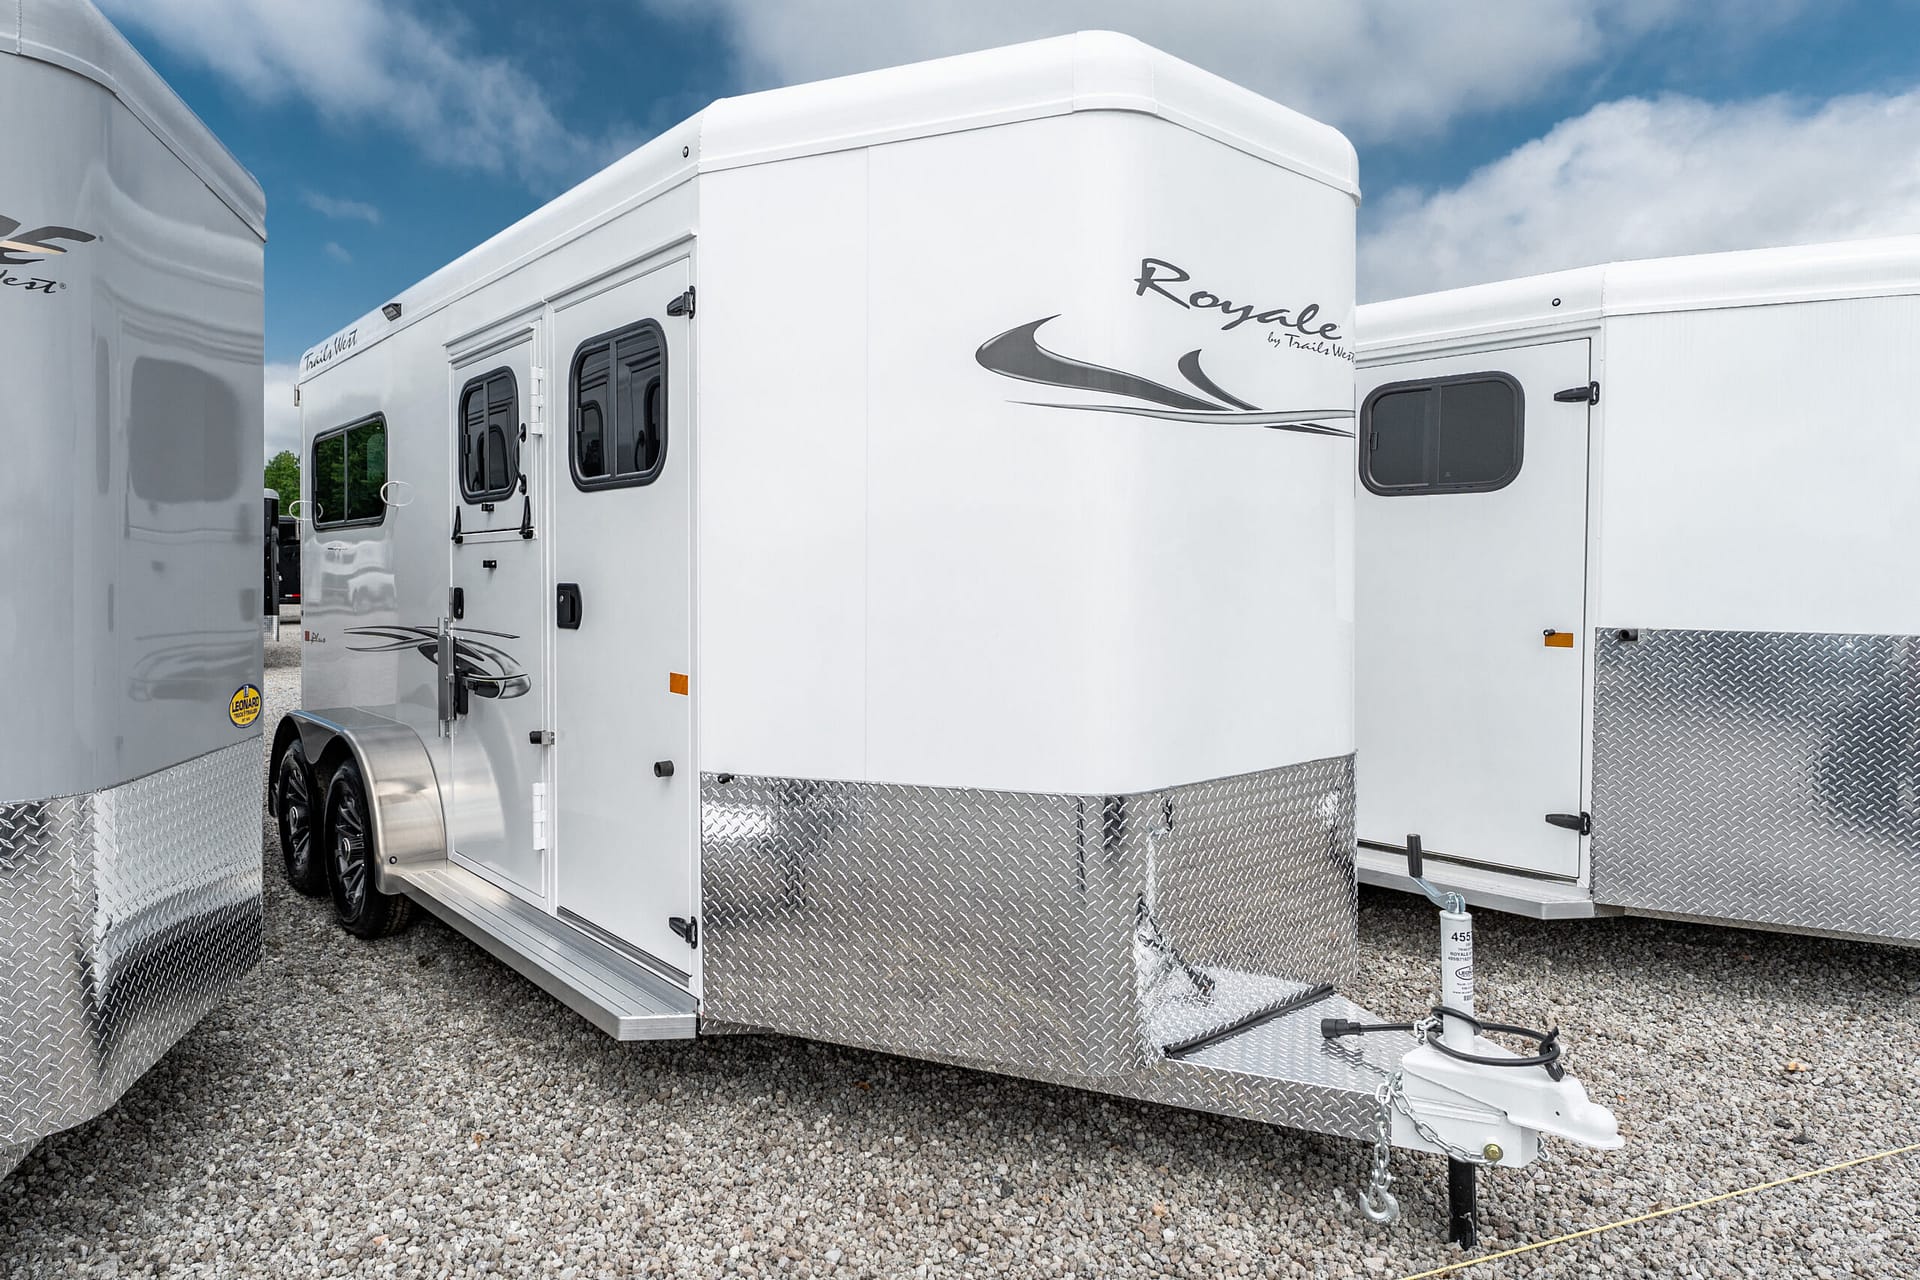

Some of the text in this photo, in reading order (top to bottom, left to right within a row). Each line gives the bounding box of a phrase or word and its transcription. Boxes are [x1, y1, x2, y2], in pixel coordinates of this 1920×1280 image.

[1134, 258, 1343, 340] Royale
[304, 328, 358, 371] Trails West
[1267, 331, 1356, 363] by Trails West
[231, 696, 259, 713] LEONARD
[1451, 931, 1473, 942] 455
